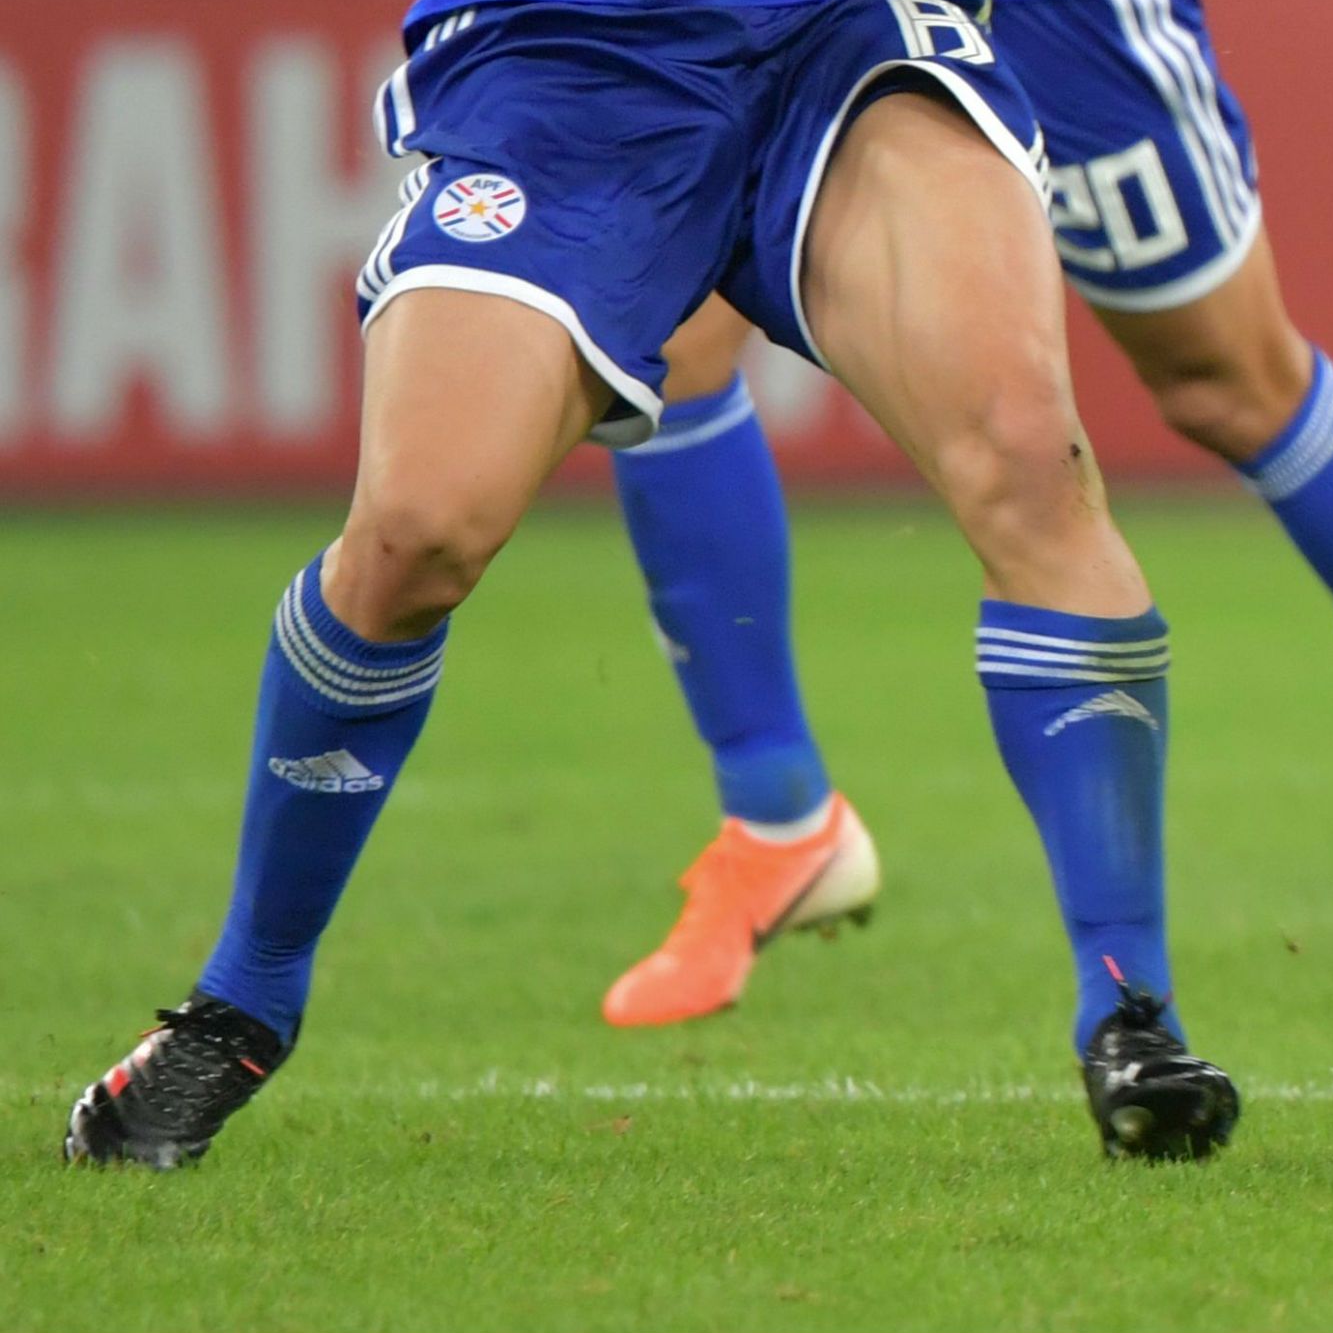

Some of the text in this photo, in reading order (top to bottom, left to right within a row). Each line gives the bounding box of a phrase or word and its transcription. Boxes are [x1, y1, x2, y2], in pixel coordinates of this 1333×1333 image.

[471, 178, 504, 191] APF
[1050, 139, 1190, 272] 20
[267, 756, 384, 794] adidas
